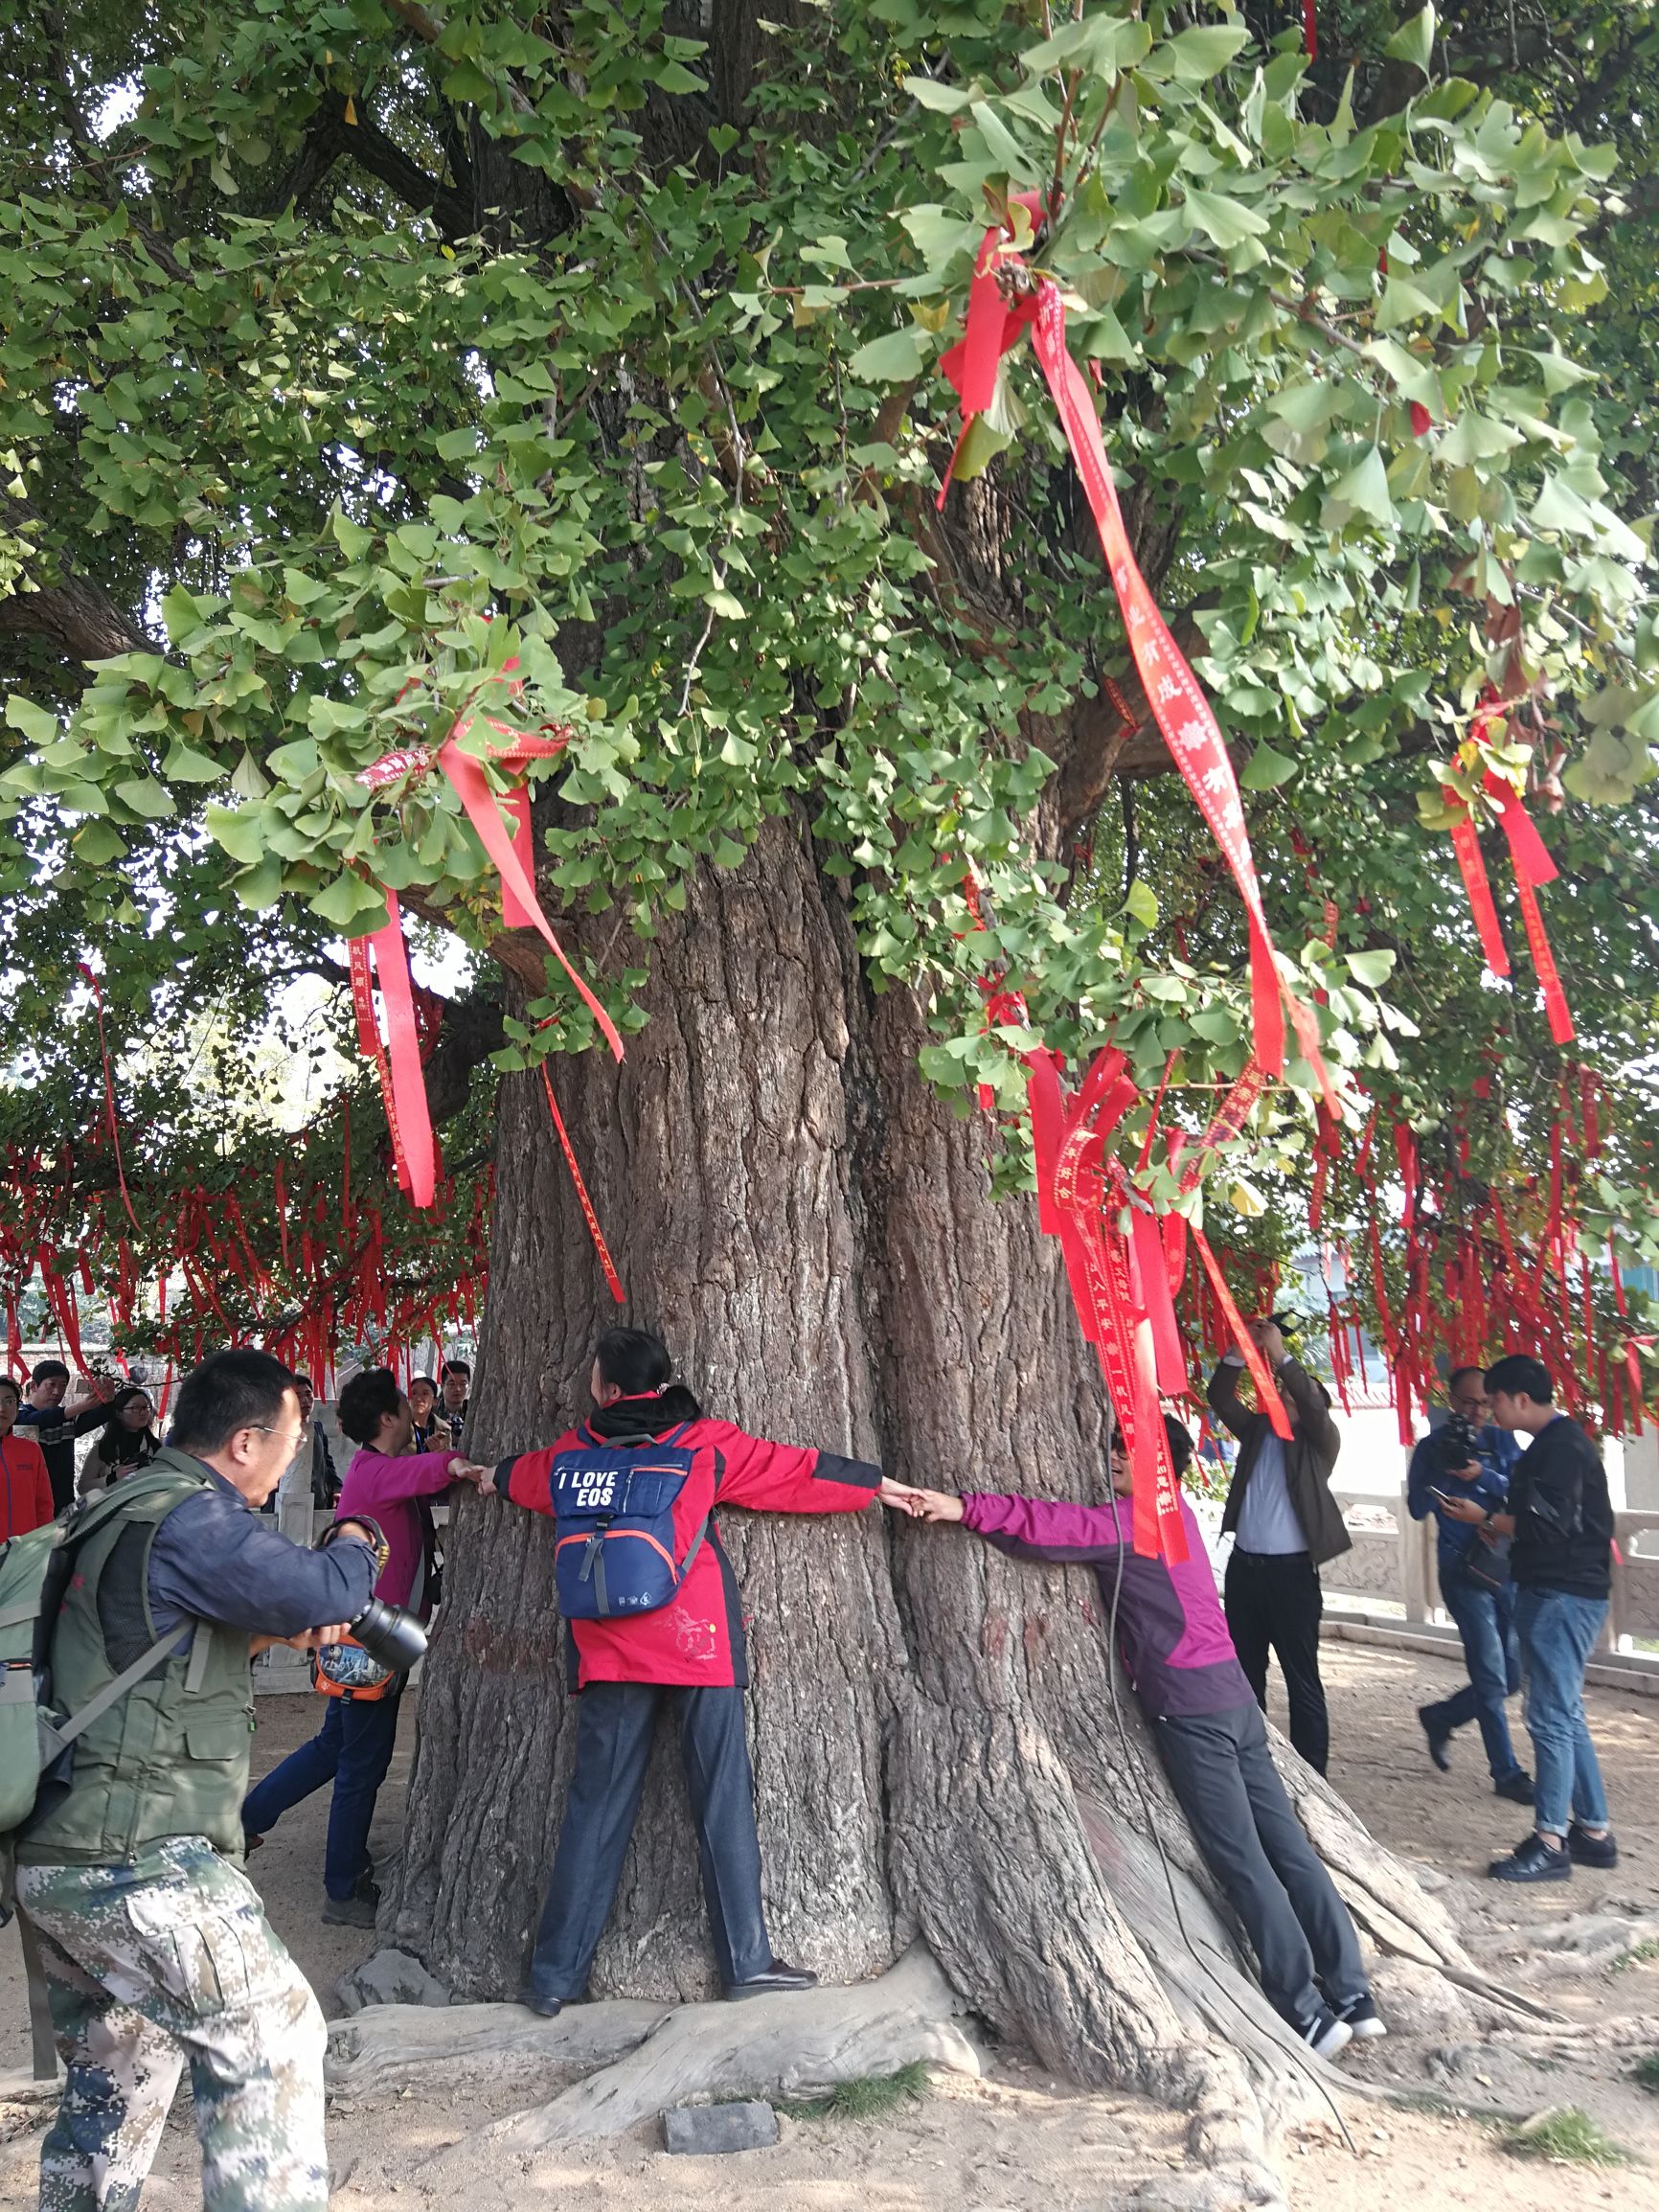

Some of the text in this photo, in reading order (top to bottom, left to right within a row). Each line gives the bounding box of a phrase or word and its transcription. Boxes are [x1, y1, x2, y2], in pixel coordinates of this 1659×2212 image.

[558, 1471, 619, 1489] I LOVE
[577, 1488, 613, 1506] EOS
